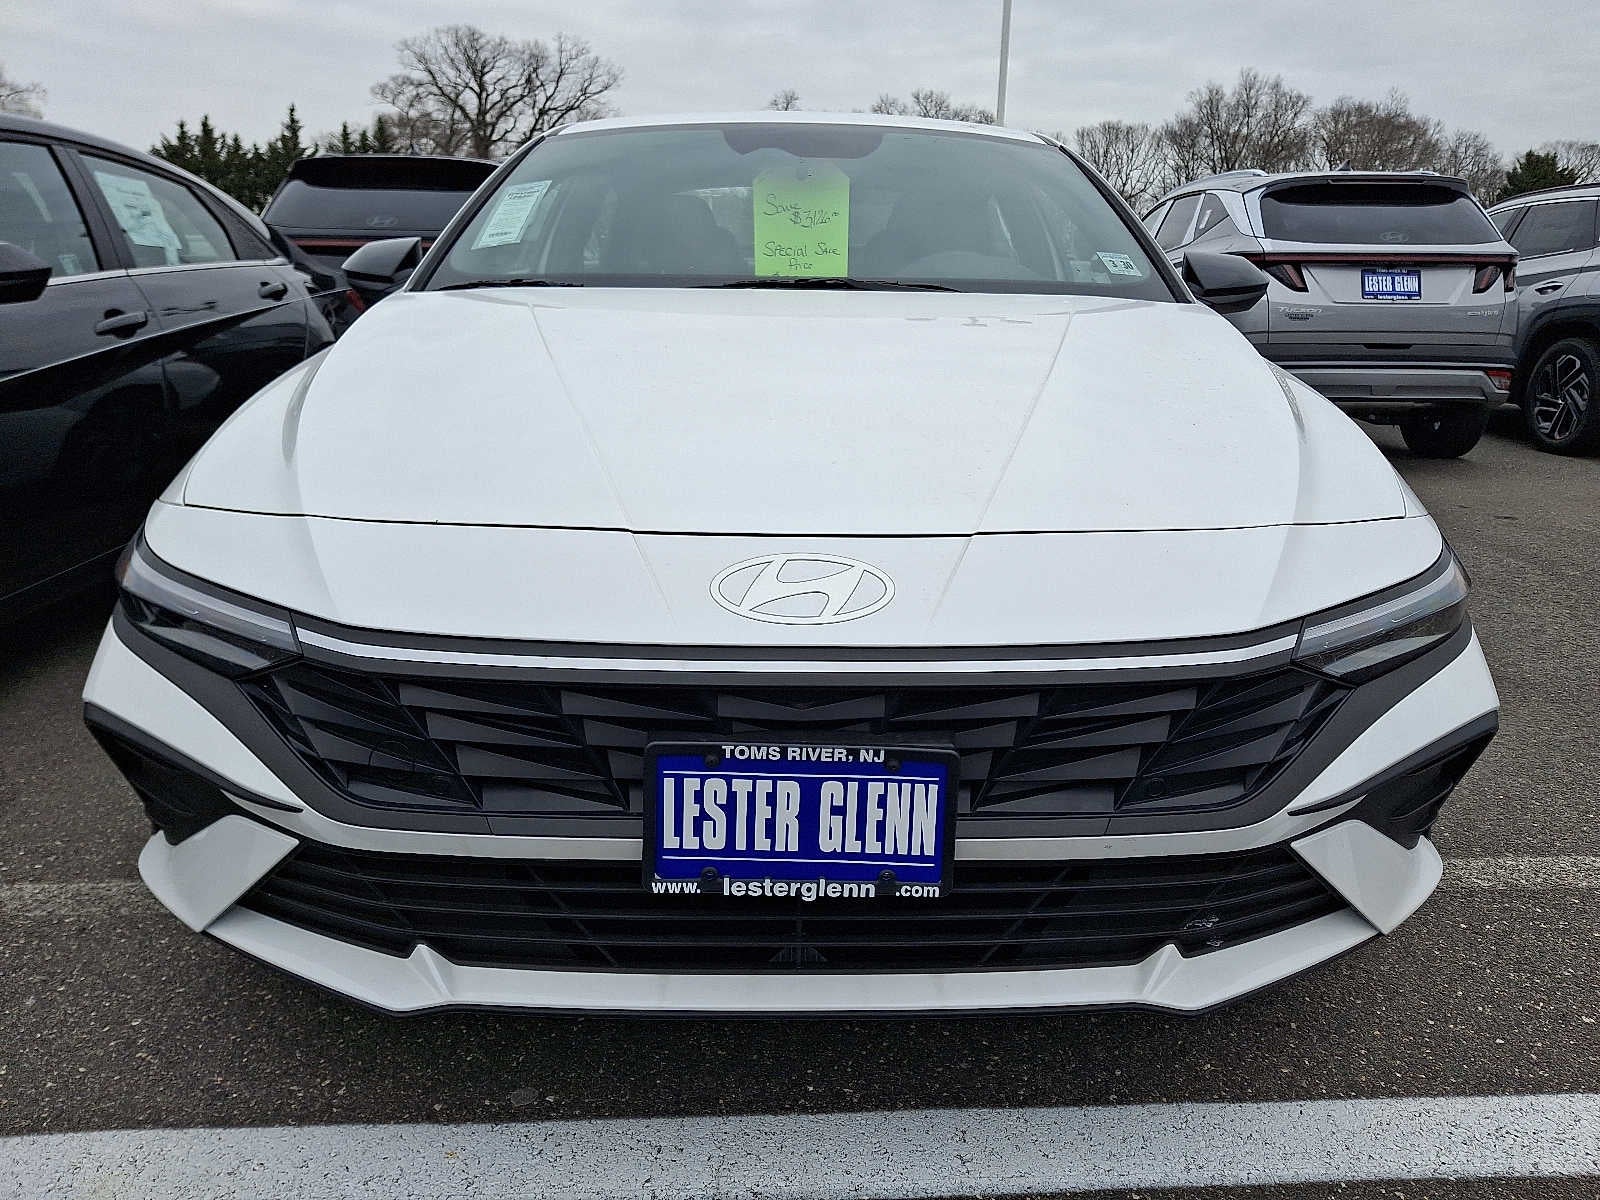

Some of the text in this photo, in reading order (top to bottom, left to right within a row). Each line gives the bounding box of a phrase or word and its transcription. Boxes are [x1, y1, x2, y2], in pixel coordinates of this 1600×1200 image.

[1364, 275, 1419, 293] LESTER GLENN
[721, 745, 885, 763] TOMS RIVER, NJ
[662, 777, 939, 856] LESTER GLENN
[651, 877, 941, 902] www. lesterglenn .com
